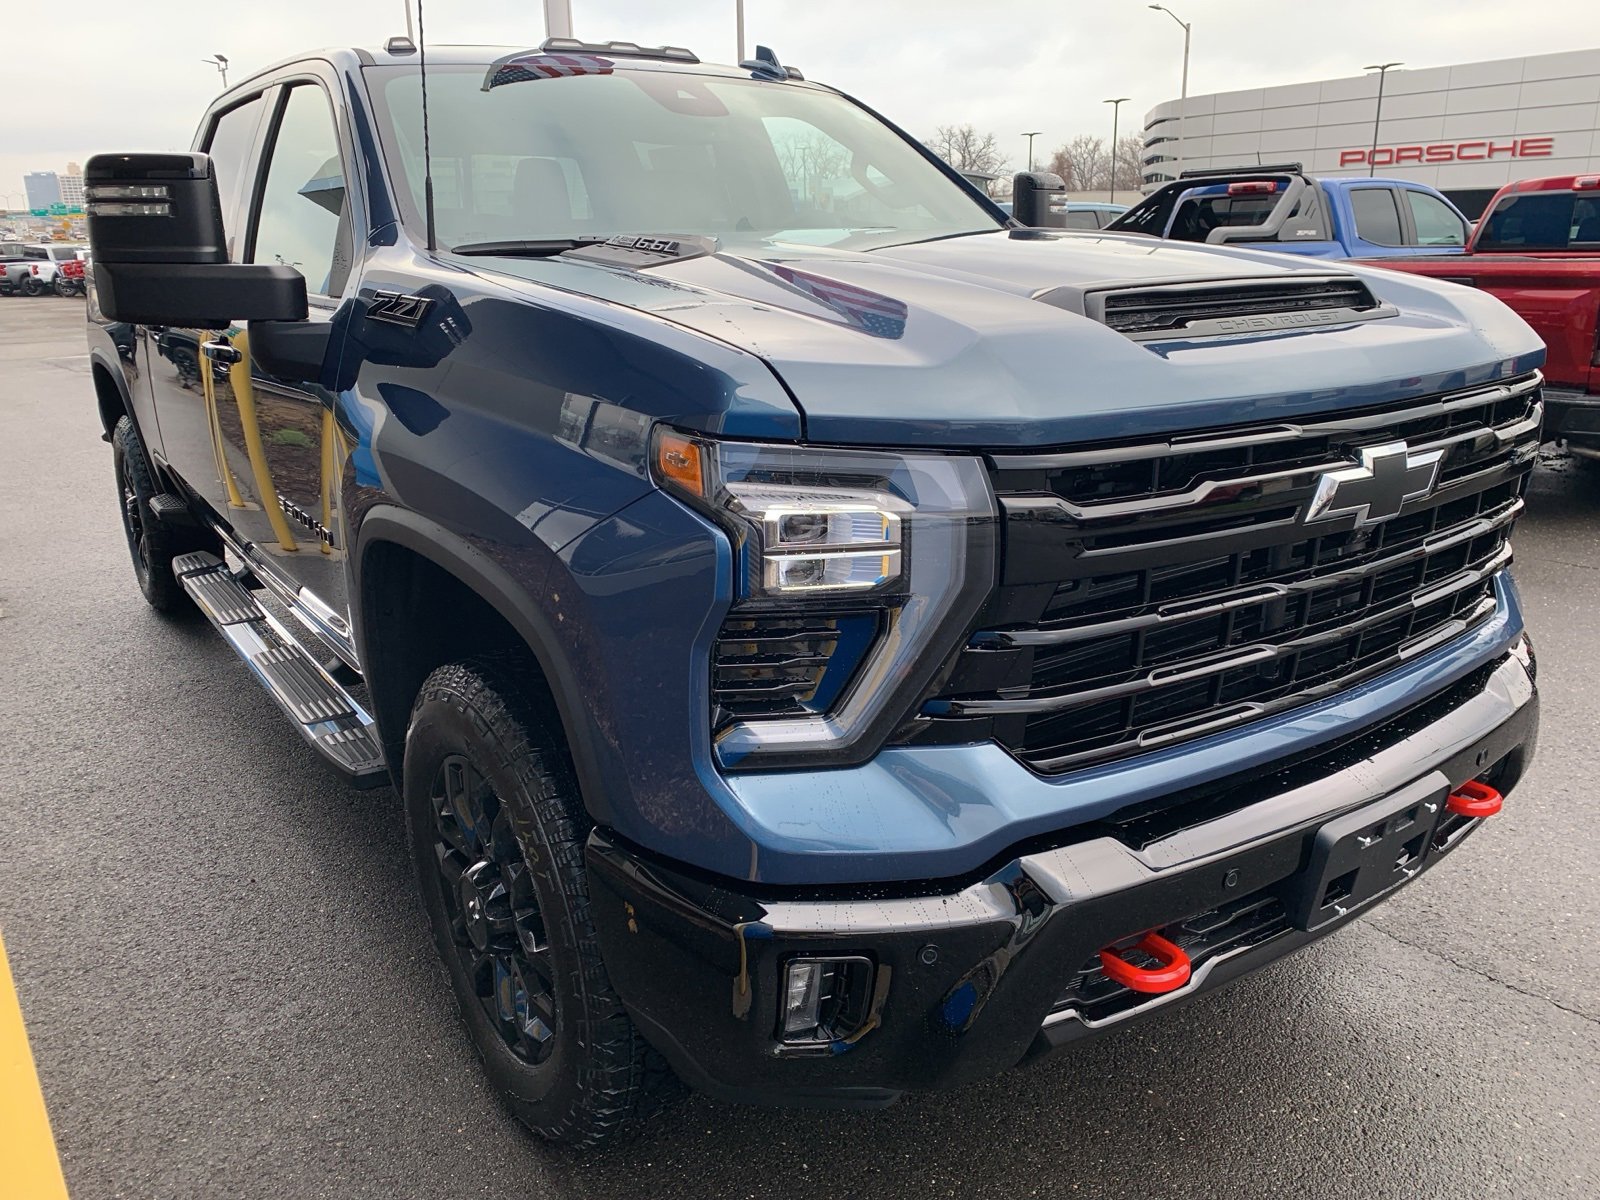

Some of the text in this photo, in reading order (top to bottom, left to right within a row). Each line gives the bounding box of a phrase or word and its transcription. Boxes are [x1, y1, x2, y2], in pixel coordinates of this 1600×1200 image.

[1340, 137, 1555, 167] PORSCHE
[634, 236, 680, 255] 6.6L
[365, 289, 435, 328] Z71
[1215, 310, 1340, 331] CHEVROLET
